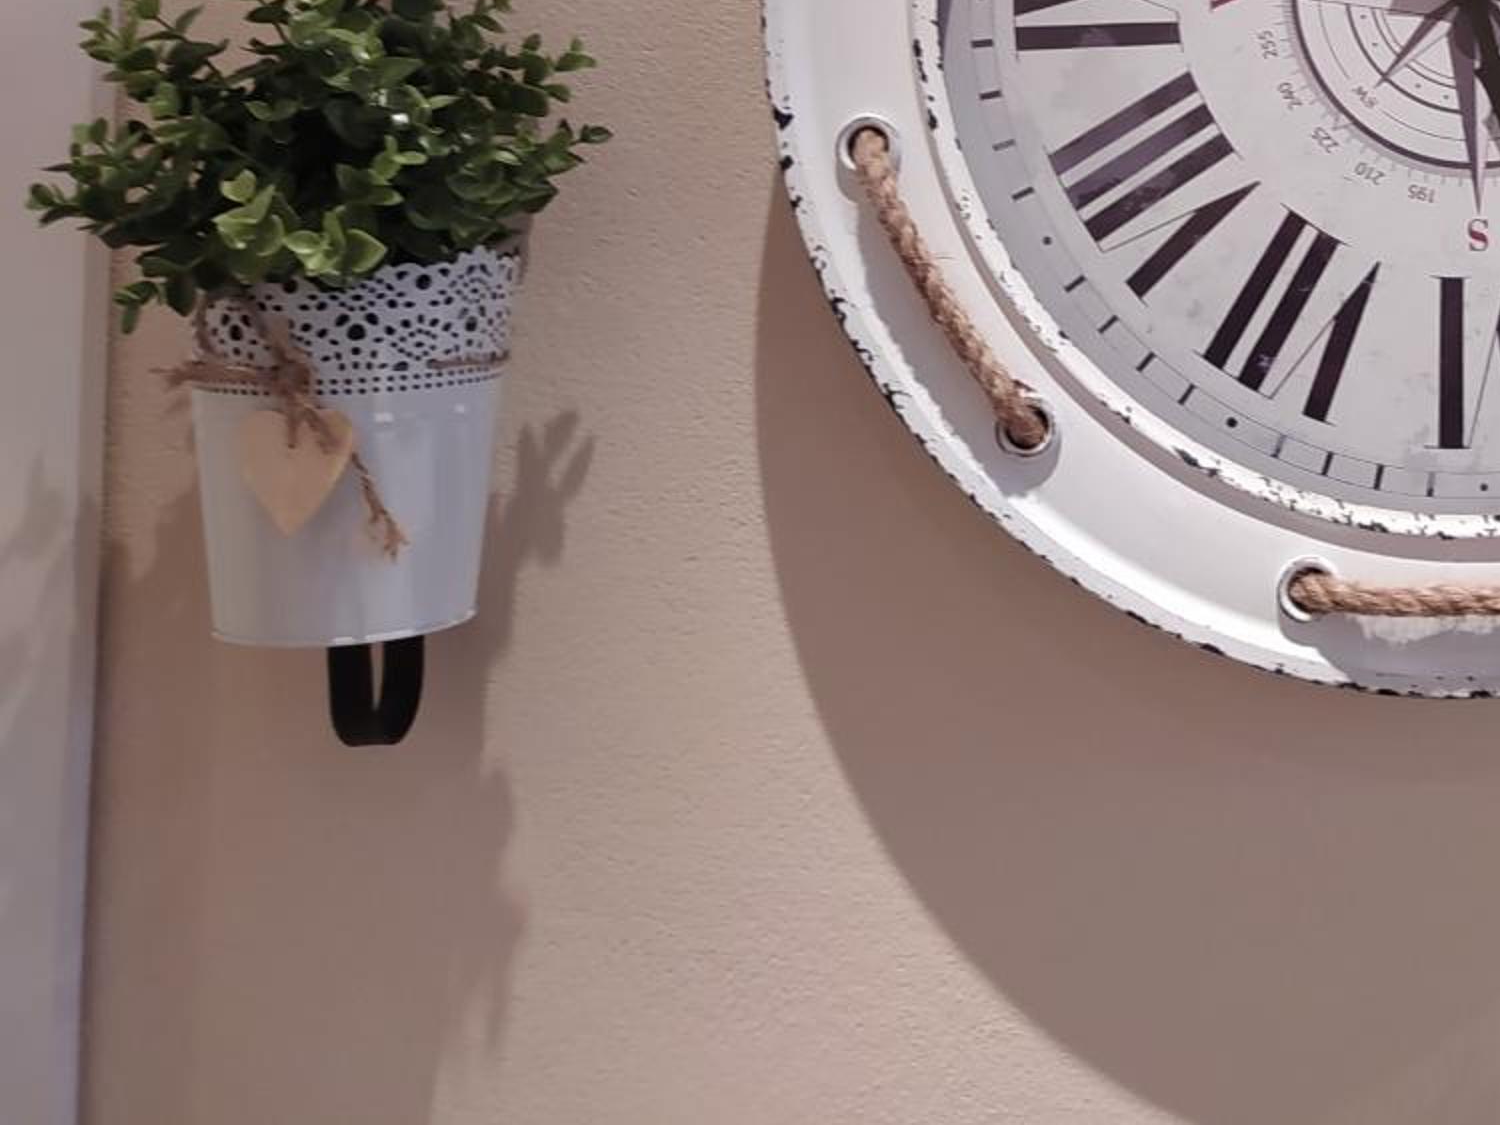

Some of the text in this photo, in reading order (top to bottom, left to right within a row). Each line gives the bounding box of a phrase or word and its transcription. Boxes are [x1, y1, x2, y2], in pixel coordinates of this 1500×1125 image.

[1256, 30, 1279, 60] 255
[1277, 80, 1303, 111] 240
[1310, 125, 1340, 154] 225
[1044, 63, 1263, 307] VIII
[1353, 159, 1386, 187] 210
[1407, 183, 1437, 204] 195
[1467, 217, 1490, 253] S
[1194, 202, 1382, 426] VII
